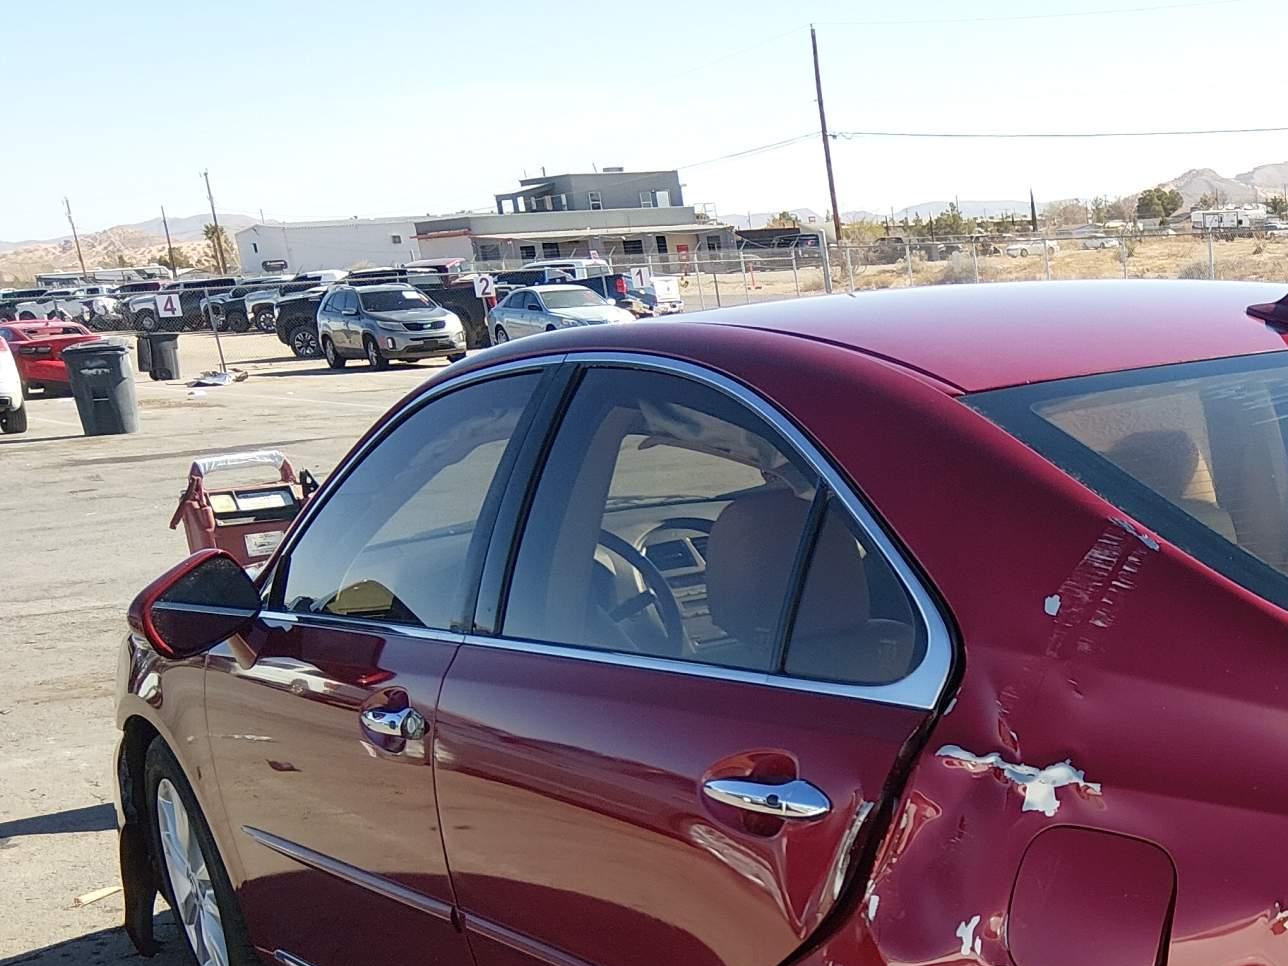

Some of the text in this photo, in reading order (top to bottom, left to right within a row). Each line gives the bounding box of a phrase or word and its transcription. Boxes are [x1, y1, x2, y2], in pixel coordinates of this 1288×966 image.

[479, 277, 492, 296] 2
[635, 268, 644, 287] 1
[163, 295, 177, 315] 4
